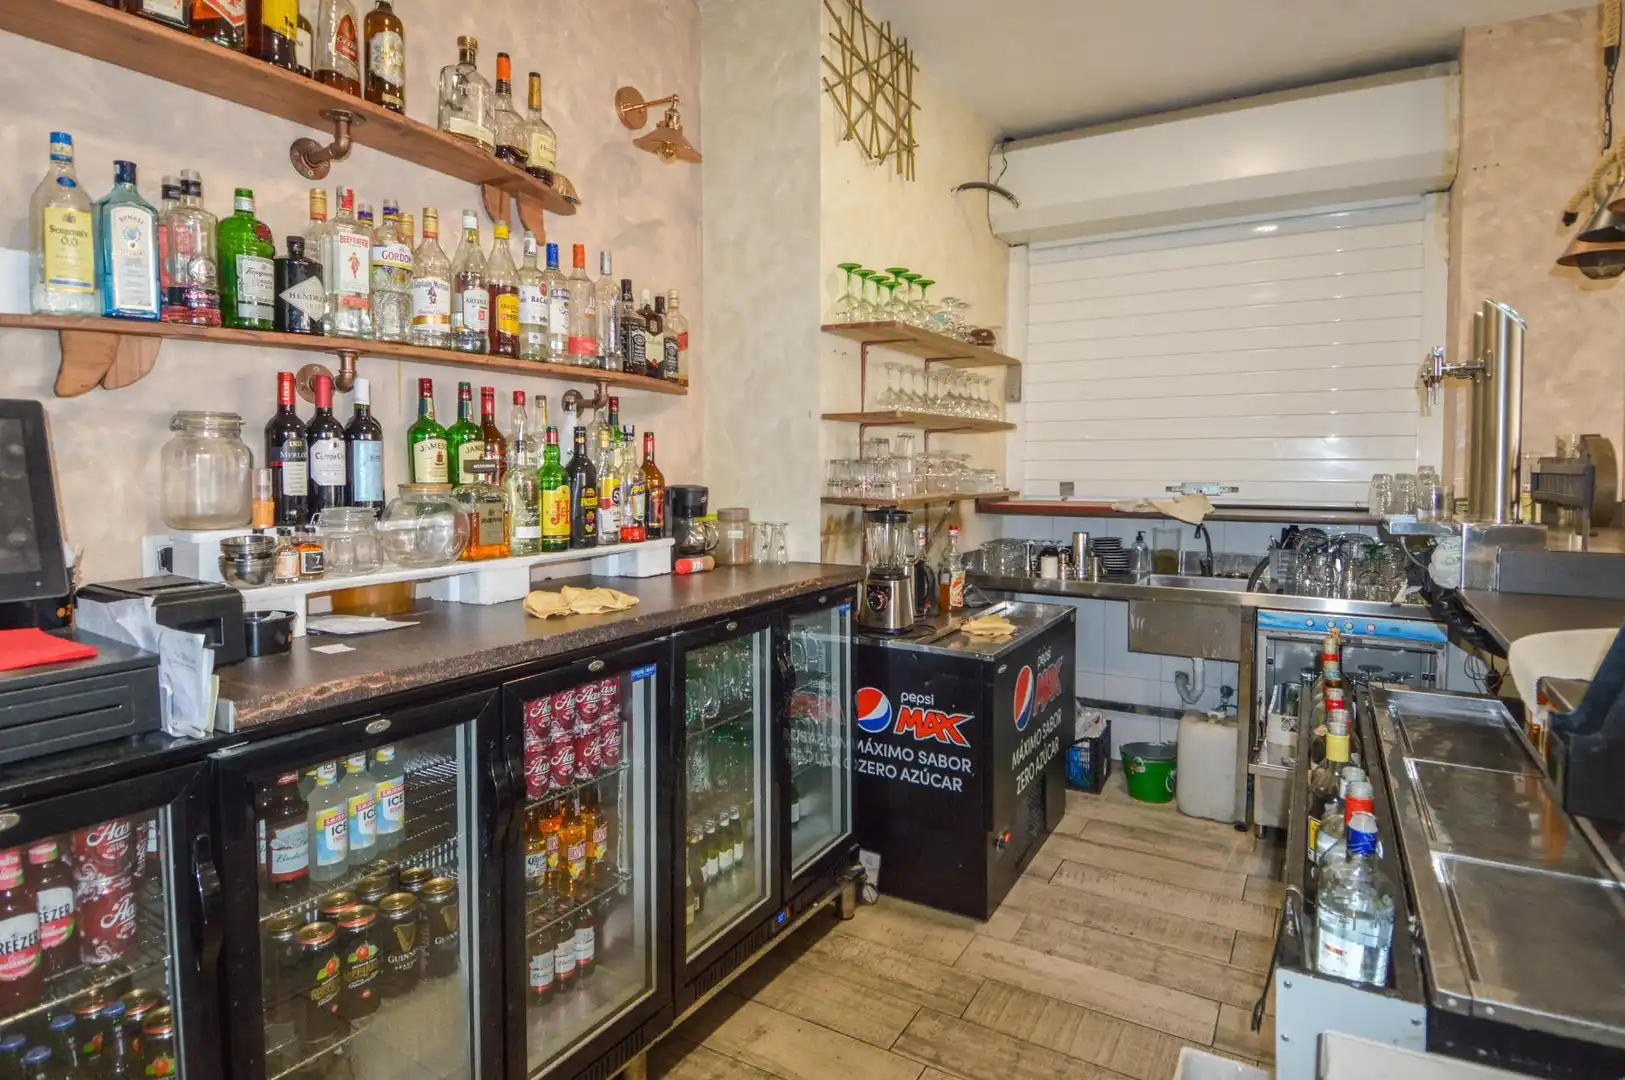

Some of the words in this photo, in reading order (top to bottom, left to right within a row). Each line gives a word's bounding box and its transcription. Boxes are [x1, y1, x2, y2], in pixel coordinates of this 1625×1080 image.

[339, 234, 369, 248] BEEFEATER
[900, 691, 934, 707] pepsi
[893, 704, 976, 749] MAX
[1011, 729, 1043, 771] MÁXIMO
[1041, 708, 1063, 740] SABOR
[857, 737, 915, 762] MÁXIMO
[858, 759, 898, 779] ZERO
[900, 768, 963, 793] AZÚCAR
[1016, 761, 1035, 796] ZERO
[1035, 735, 1060, 774] AZÚCAR
[387, 794, 404, 808] ICE
